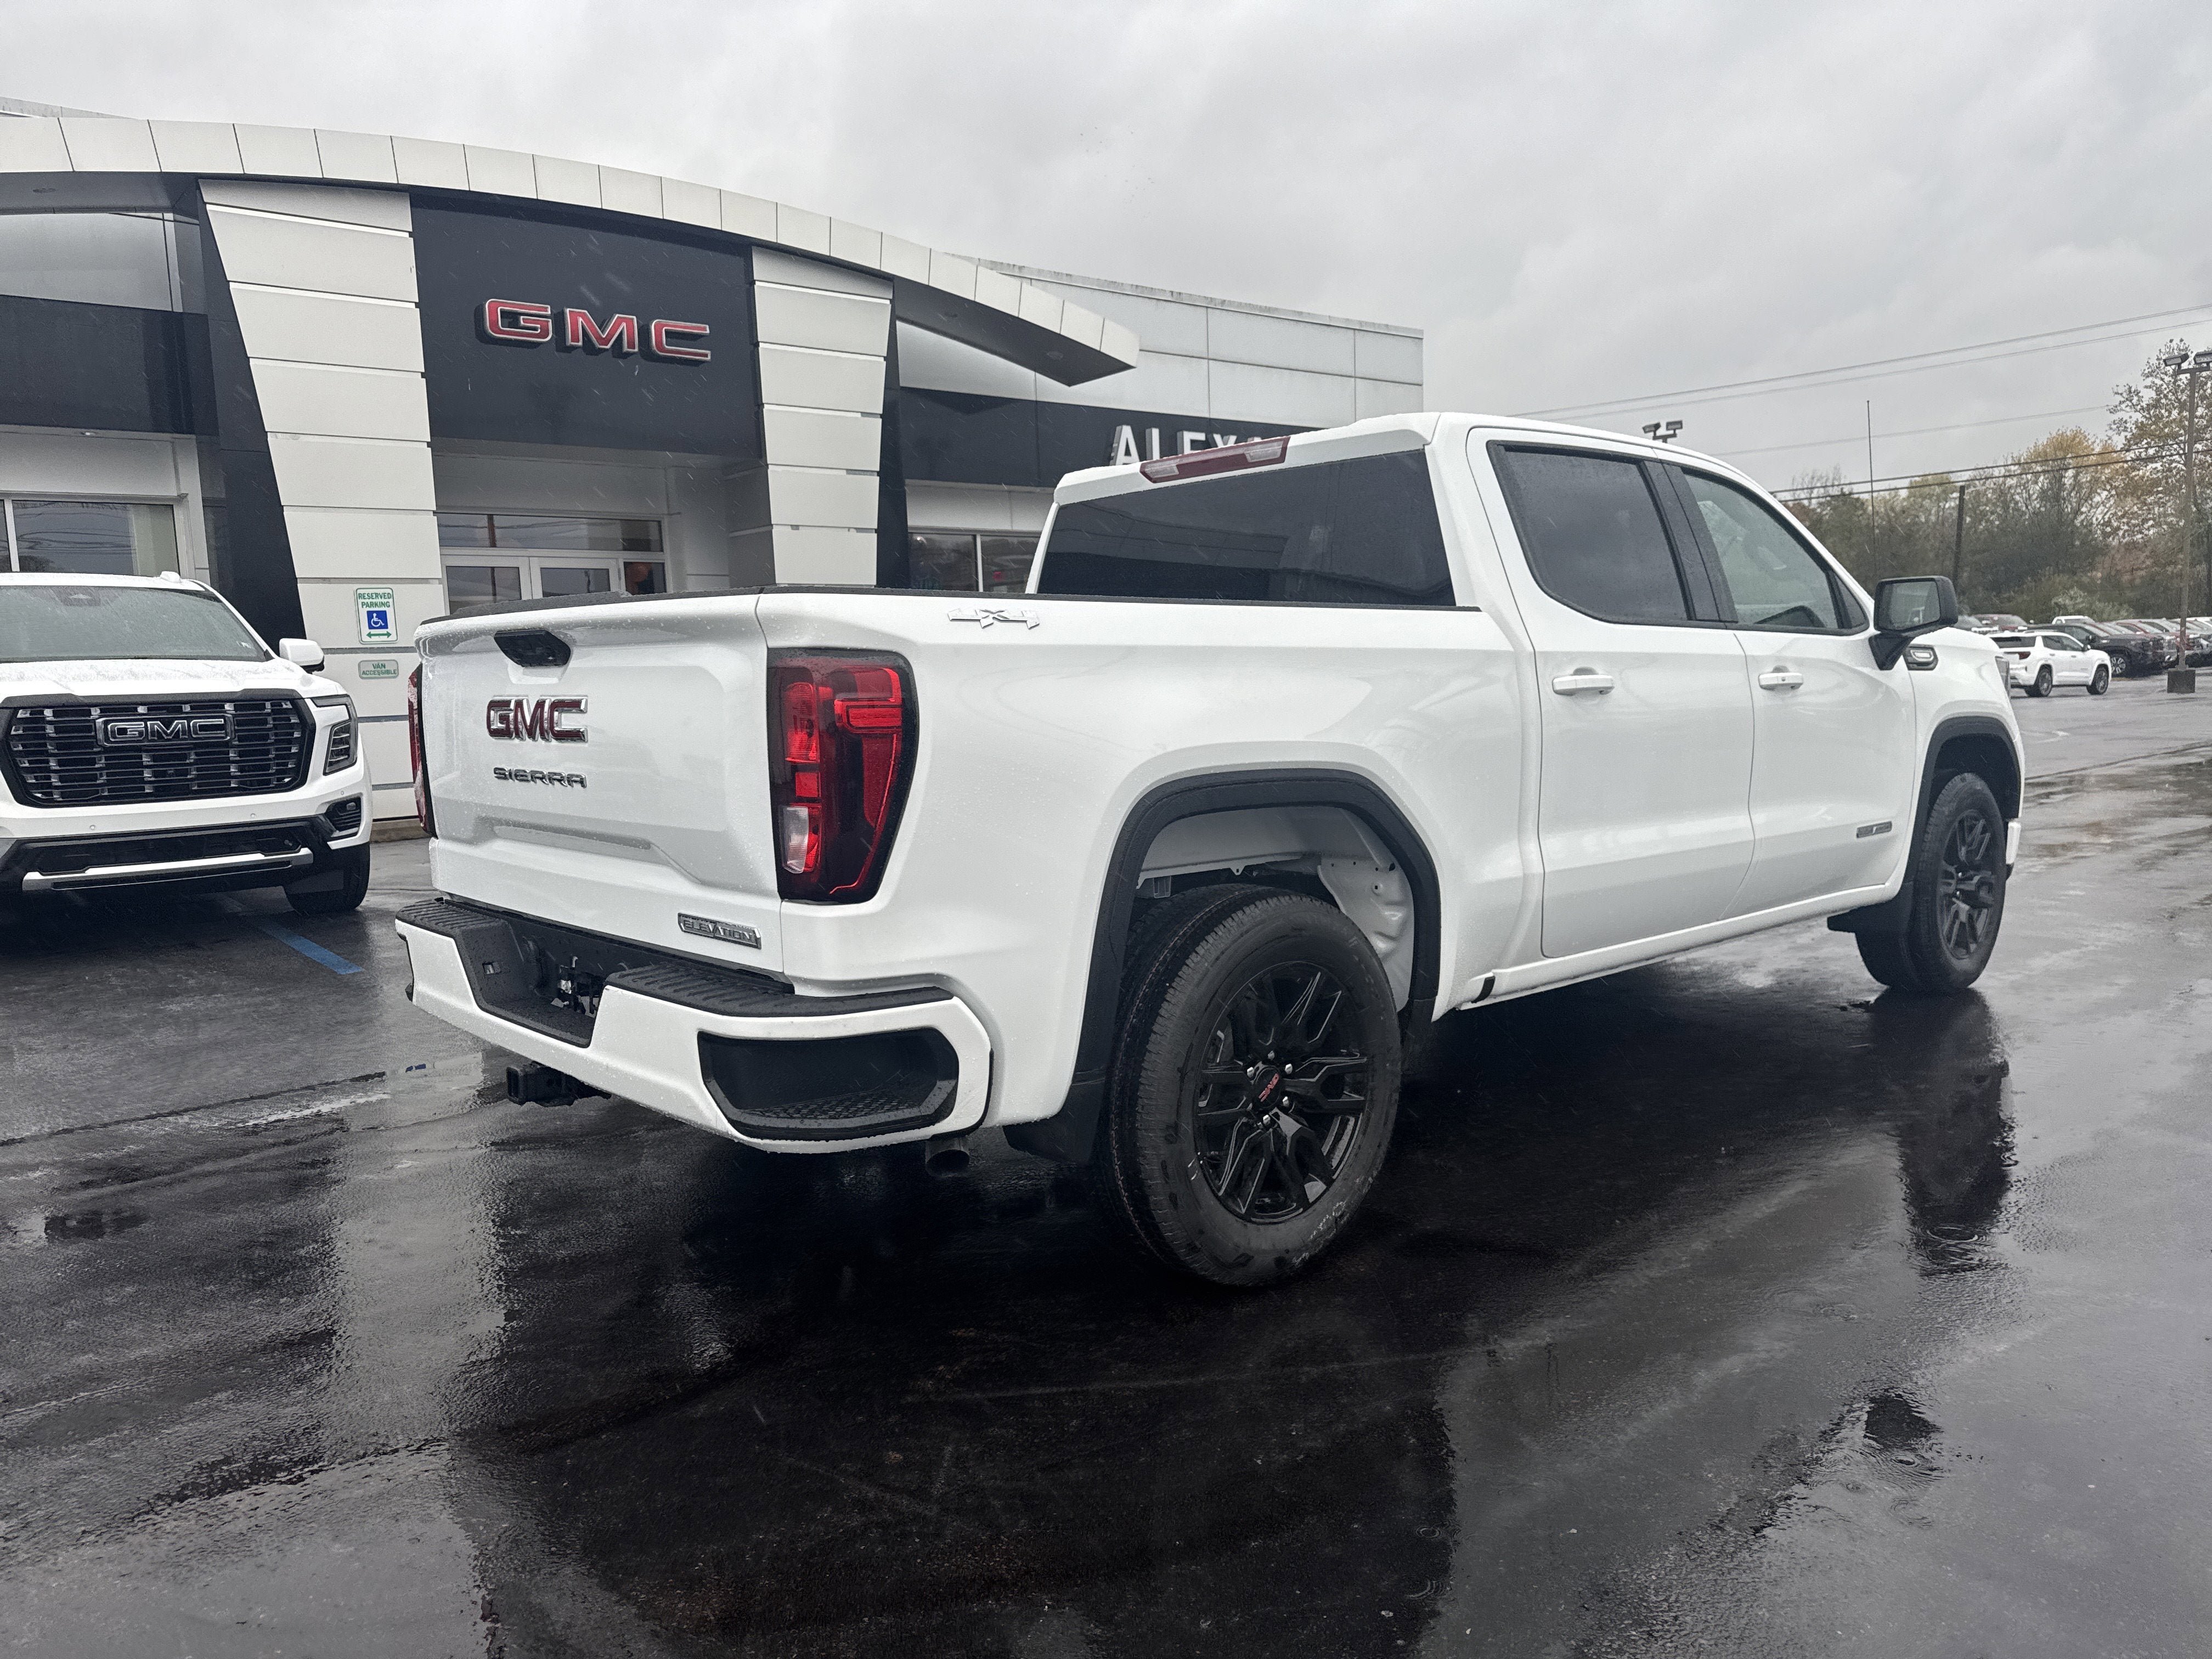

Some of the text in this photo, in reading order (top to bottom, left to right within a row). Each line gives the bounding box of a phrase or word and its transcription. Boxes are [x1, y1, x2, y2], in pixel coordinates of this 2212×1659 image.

[484, 298, 712, 362] GMC
[1111, 425, 1265, 466] ALE
[107, 718, 225, 742] GMC
[486, 697, 588, 743] GMC
[493, 766, 588, 789] SIERRA
[682, 918, 756, 944] ELEVATION
